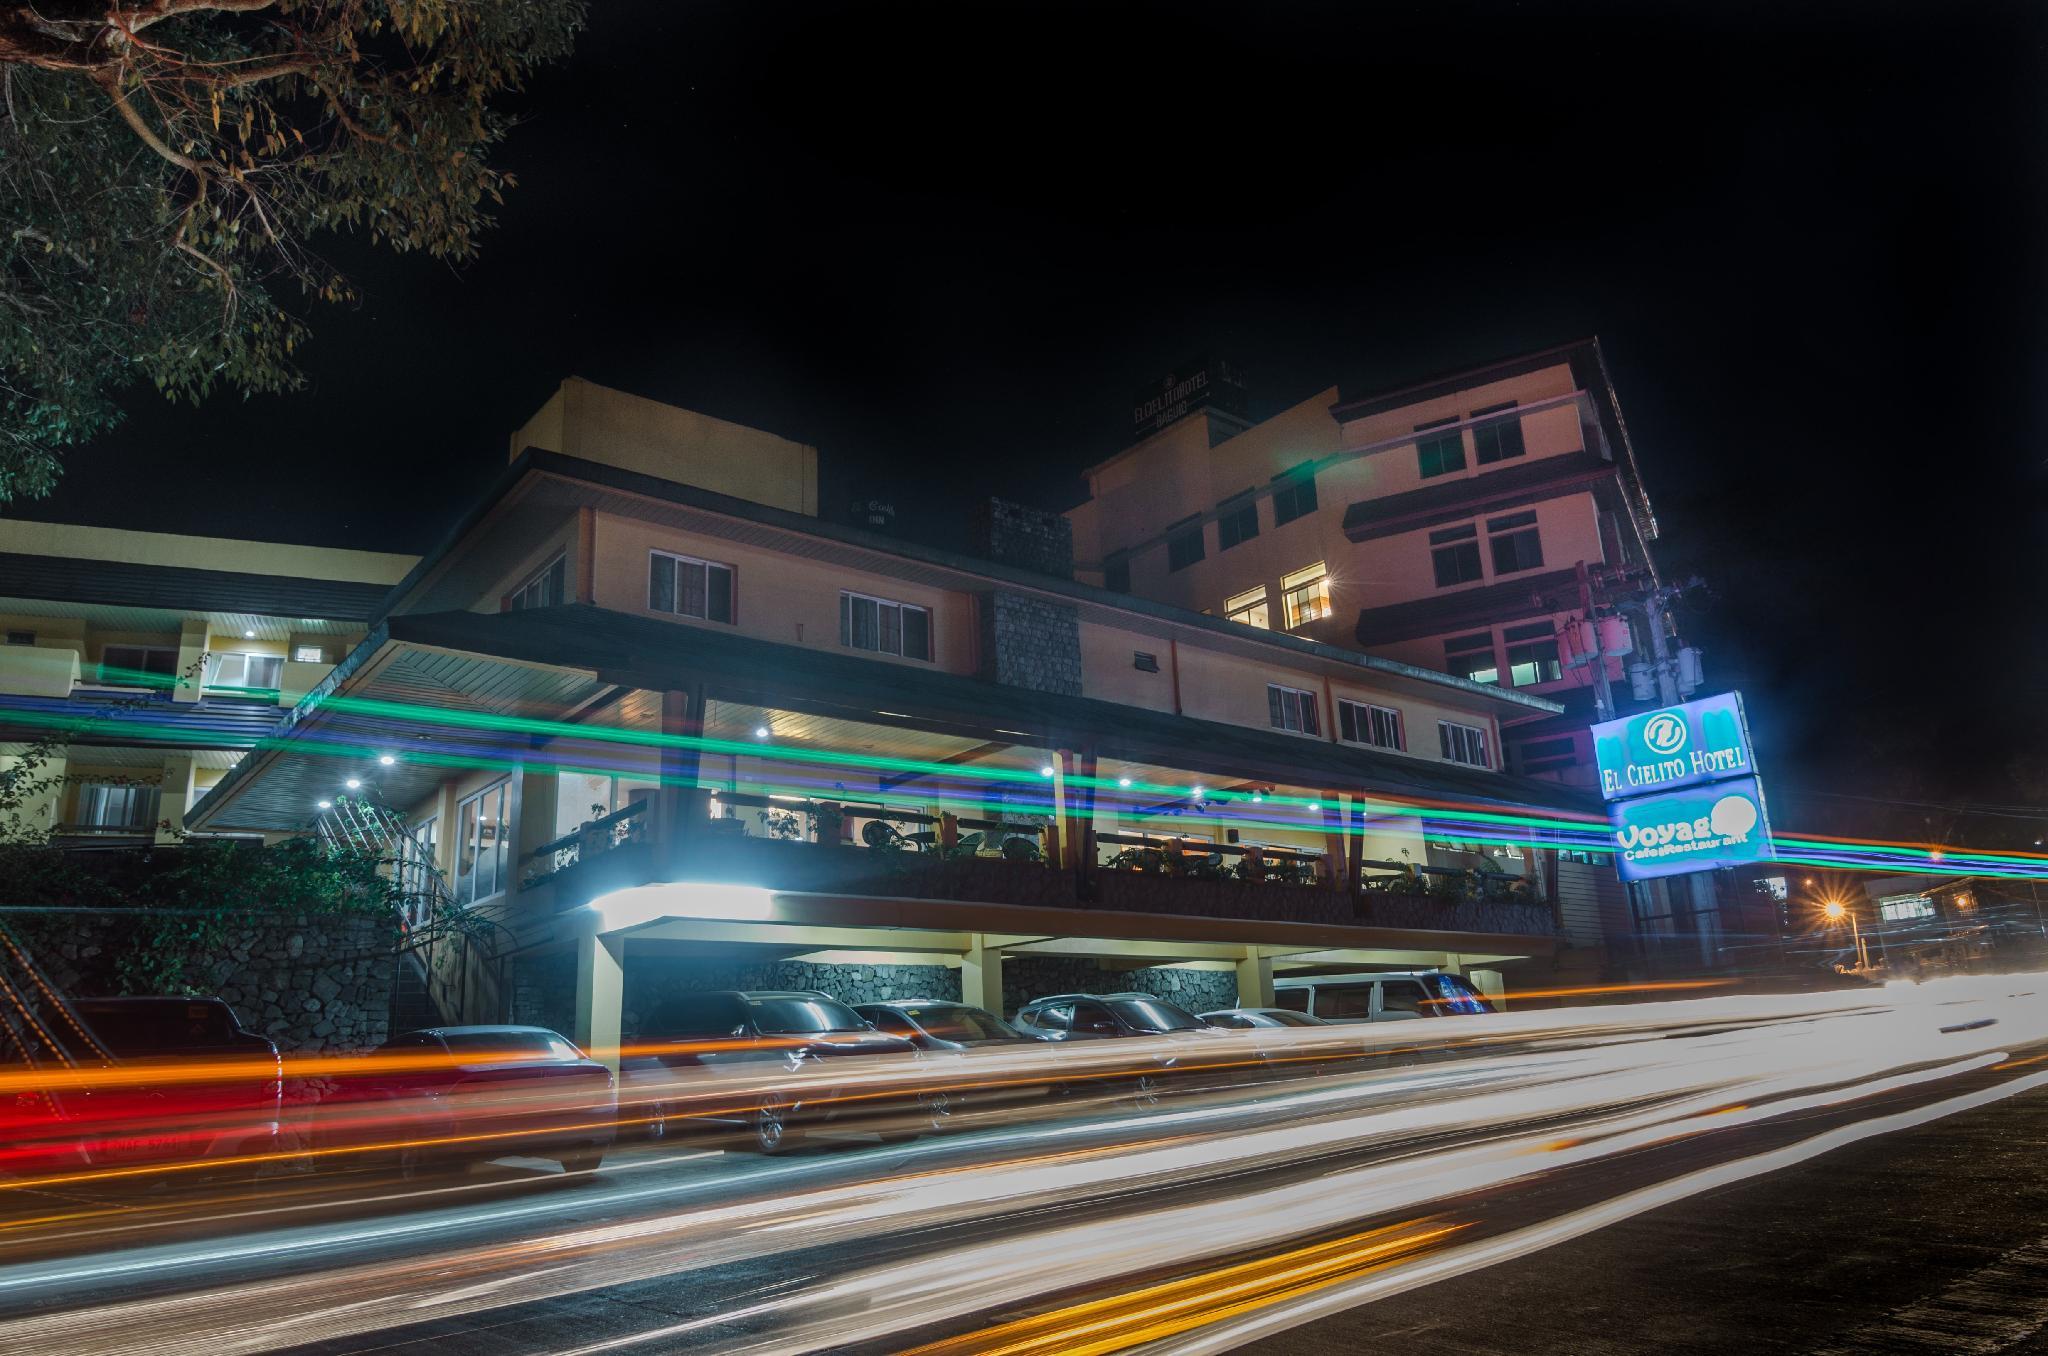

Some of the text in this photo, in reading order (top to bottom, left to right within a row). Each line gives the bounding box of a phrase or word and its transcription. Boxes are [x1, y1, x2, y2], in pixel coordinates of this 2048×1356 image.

[1603, 746, 1746, 792] EL CIELITO HOTEL
